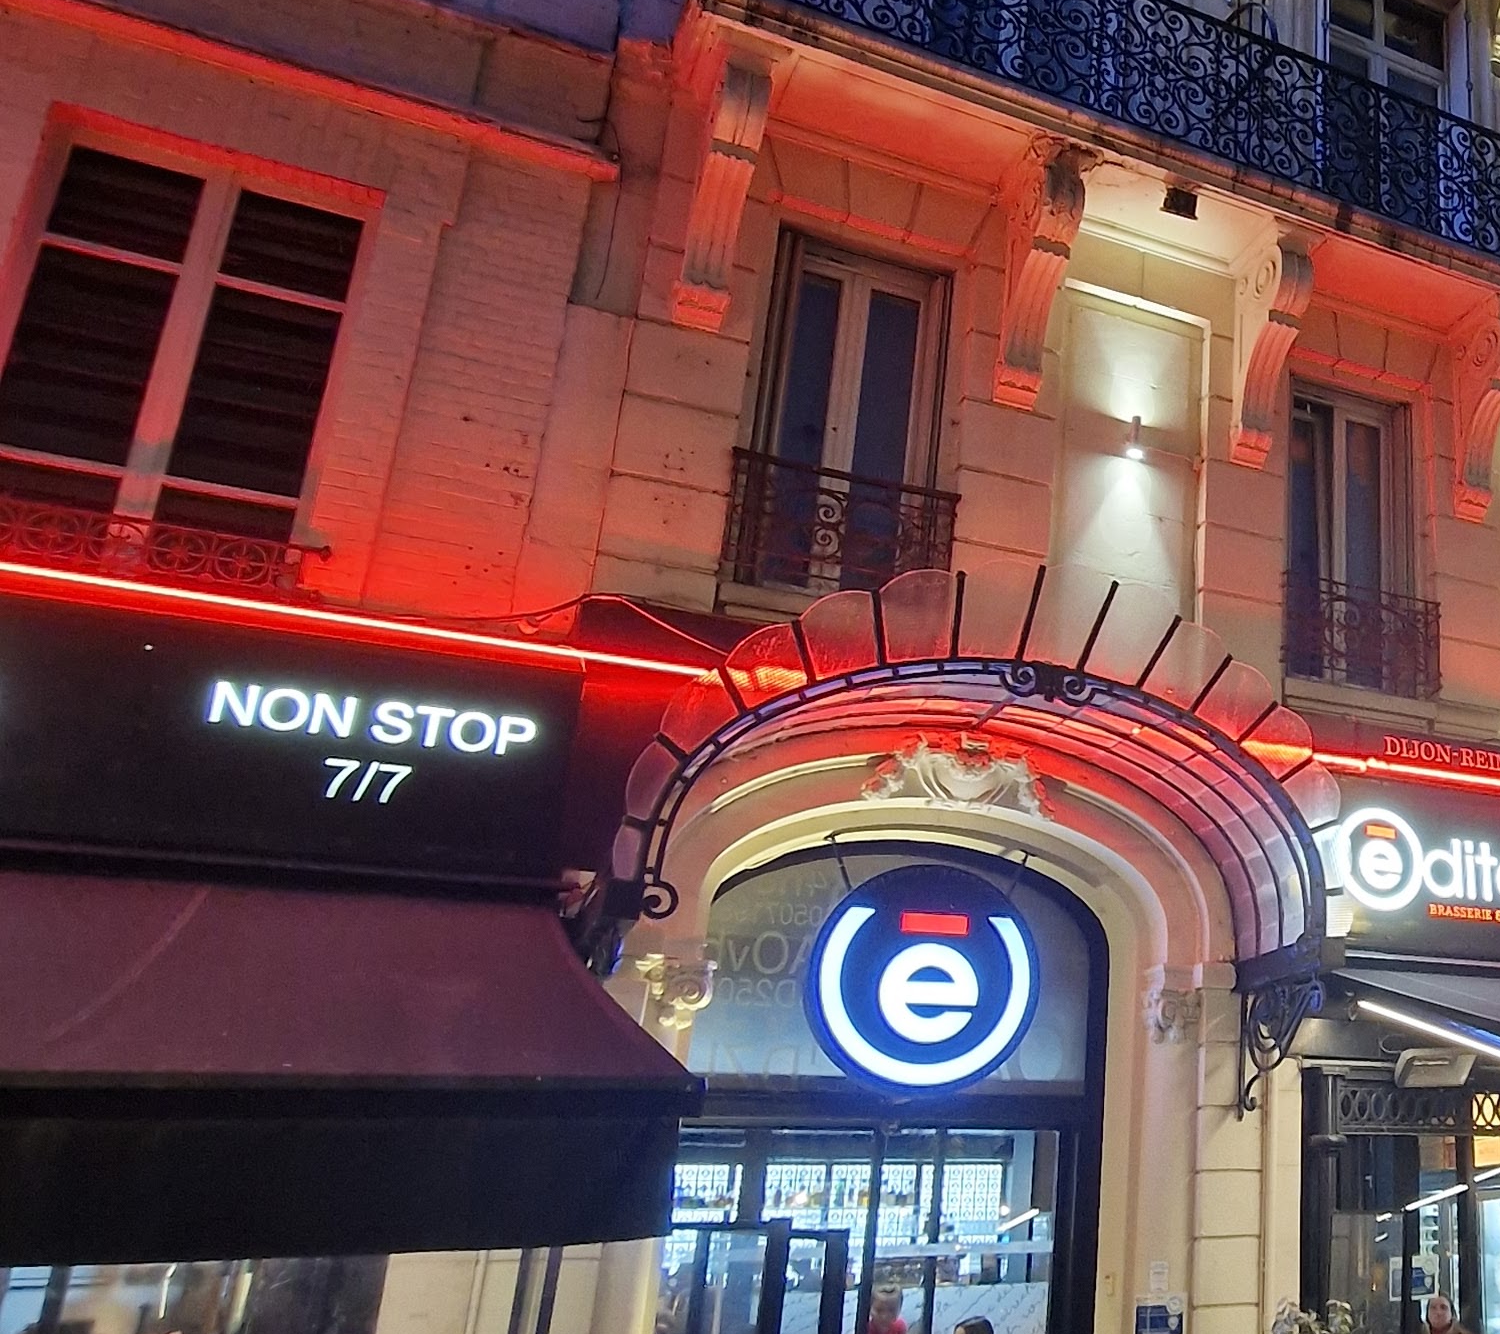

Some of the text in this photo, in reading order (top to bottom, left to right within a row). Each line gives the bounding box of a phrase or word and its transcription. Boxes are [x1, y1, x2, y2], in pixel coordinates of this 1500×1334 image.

[207, 679, 539, 755] NON STOP
[323, 757, 412, 803] 7/7
[1429, 903, 1493, 921] BRASSERIE
